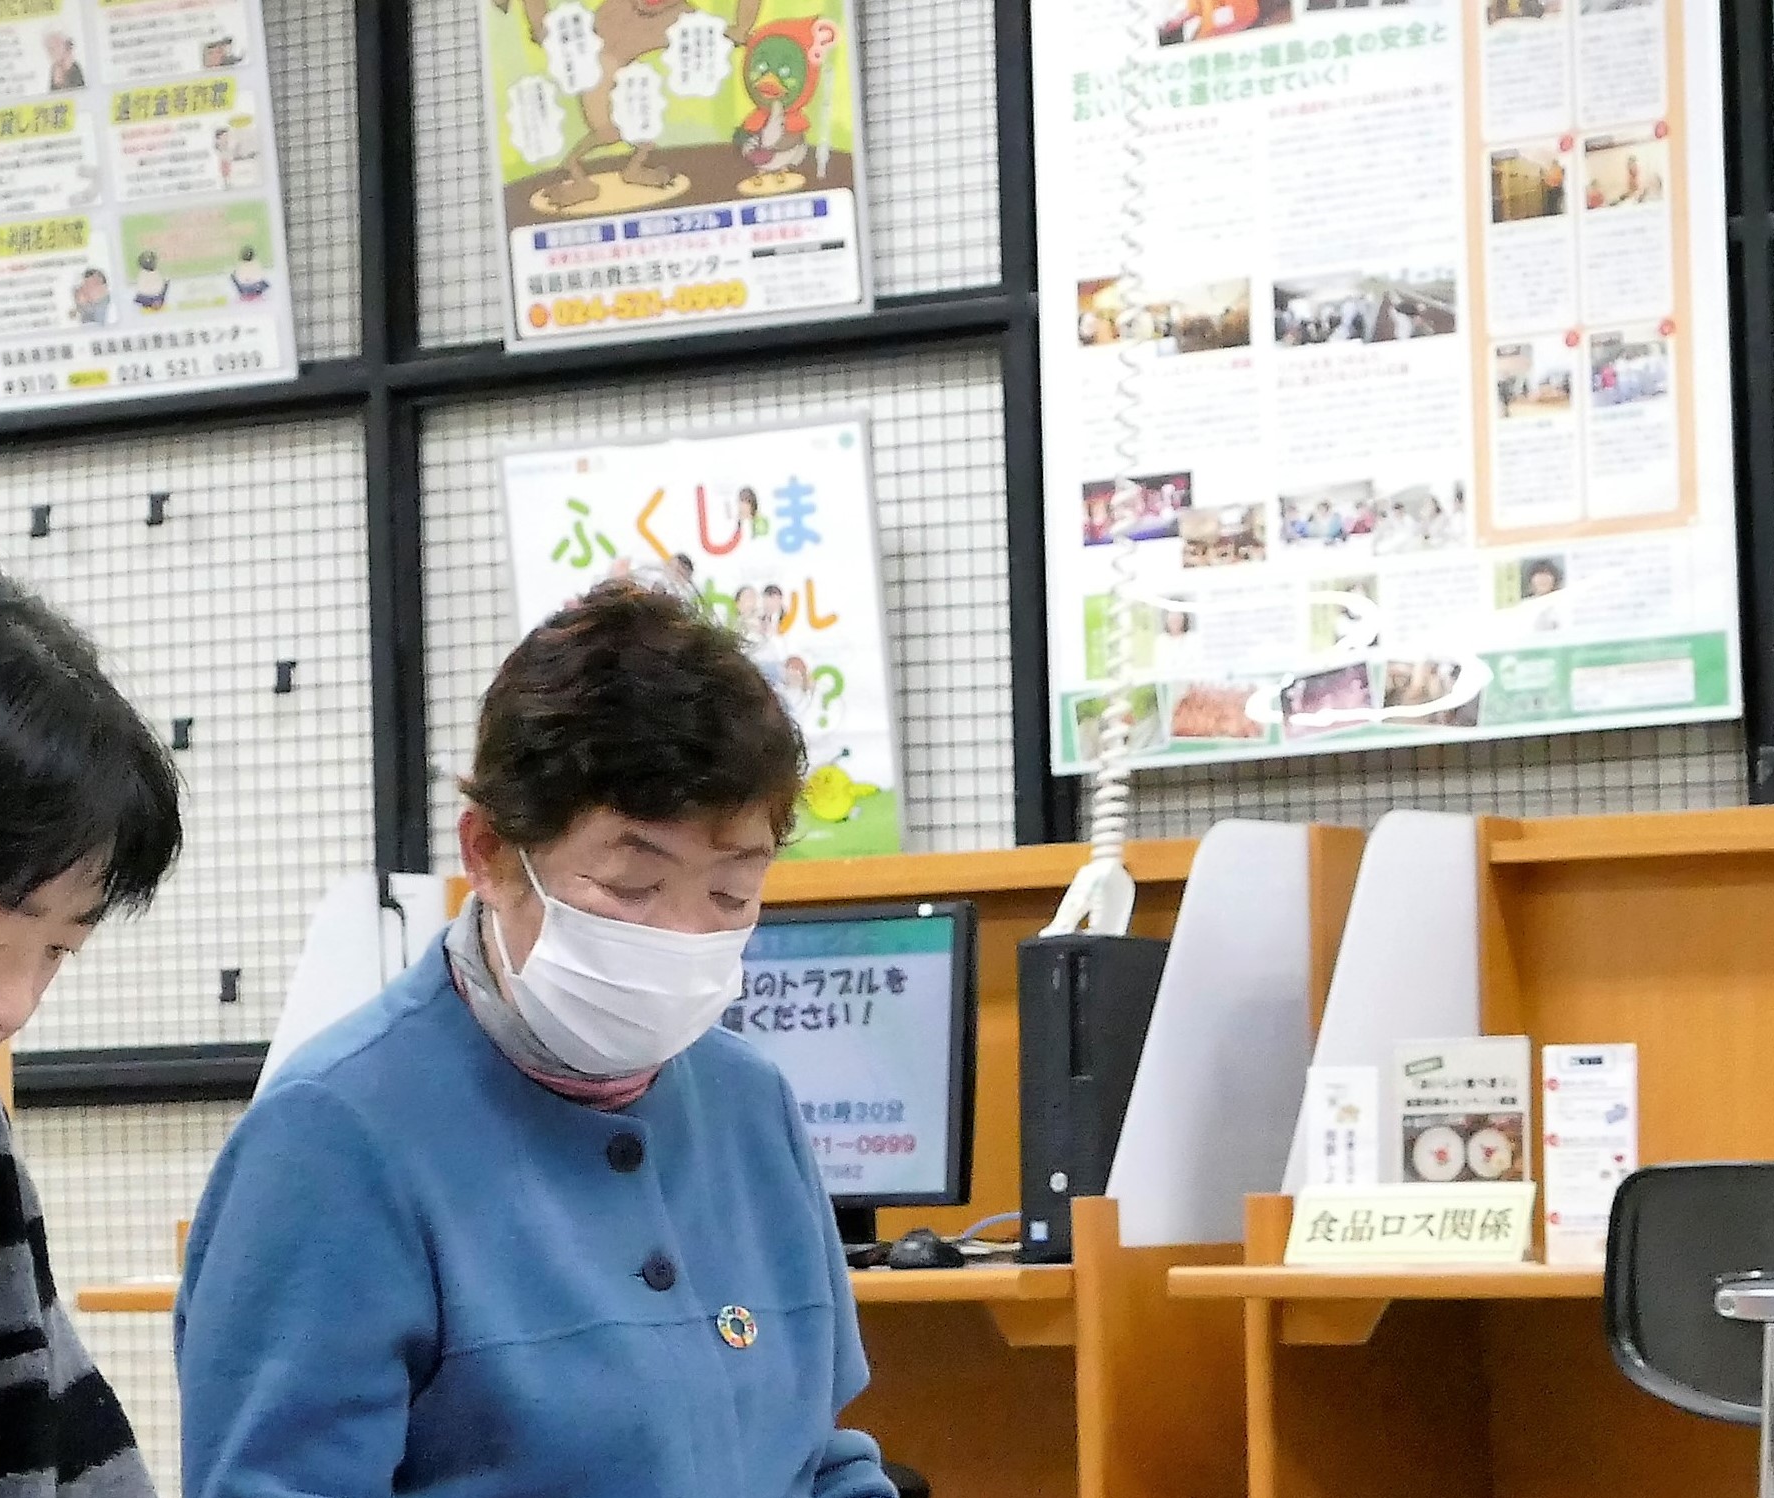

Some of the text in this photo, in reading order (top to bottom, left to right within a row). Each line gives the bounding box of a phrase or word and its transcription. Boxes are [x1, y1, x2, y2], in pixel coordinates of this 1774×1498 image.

[551, 475, 822, 569] ふくしま
[738, 966, 909, 1001] のトラブルを
[1306, 1207, 1514, 1243] 食品ロス関係
